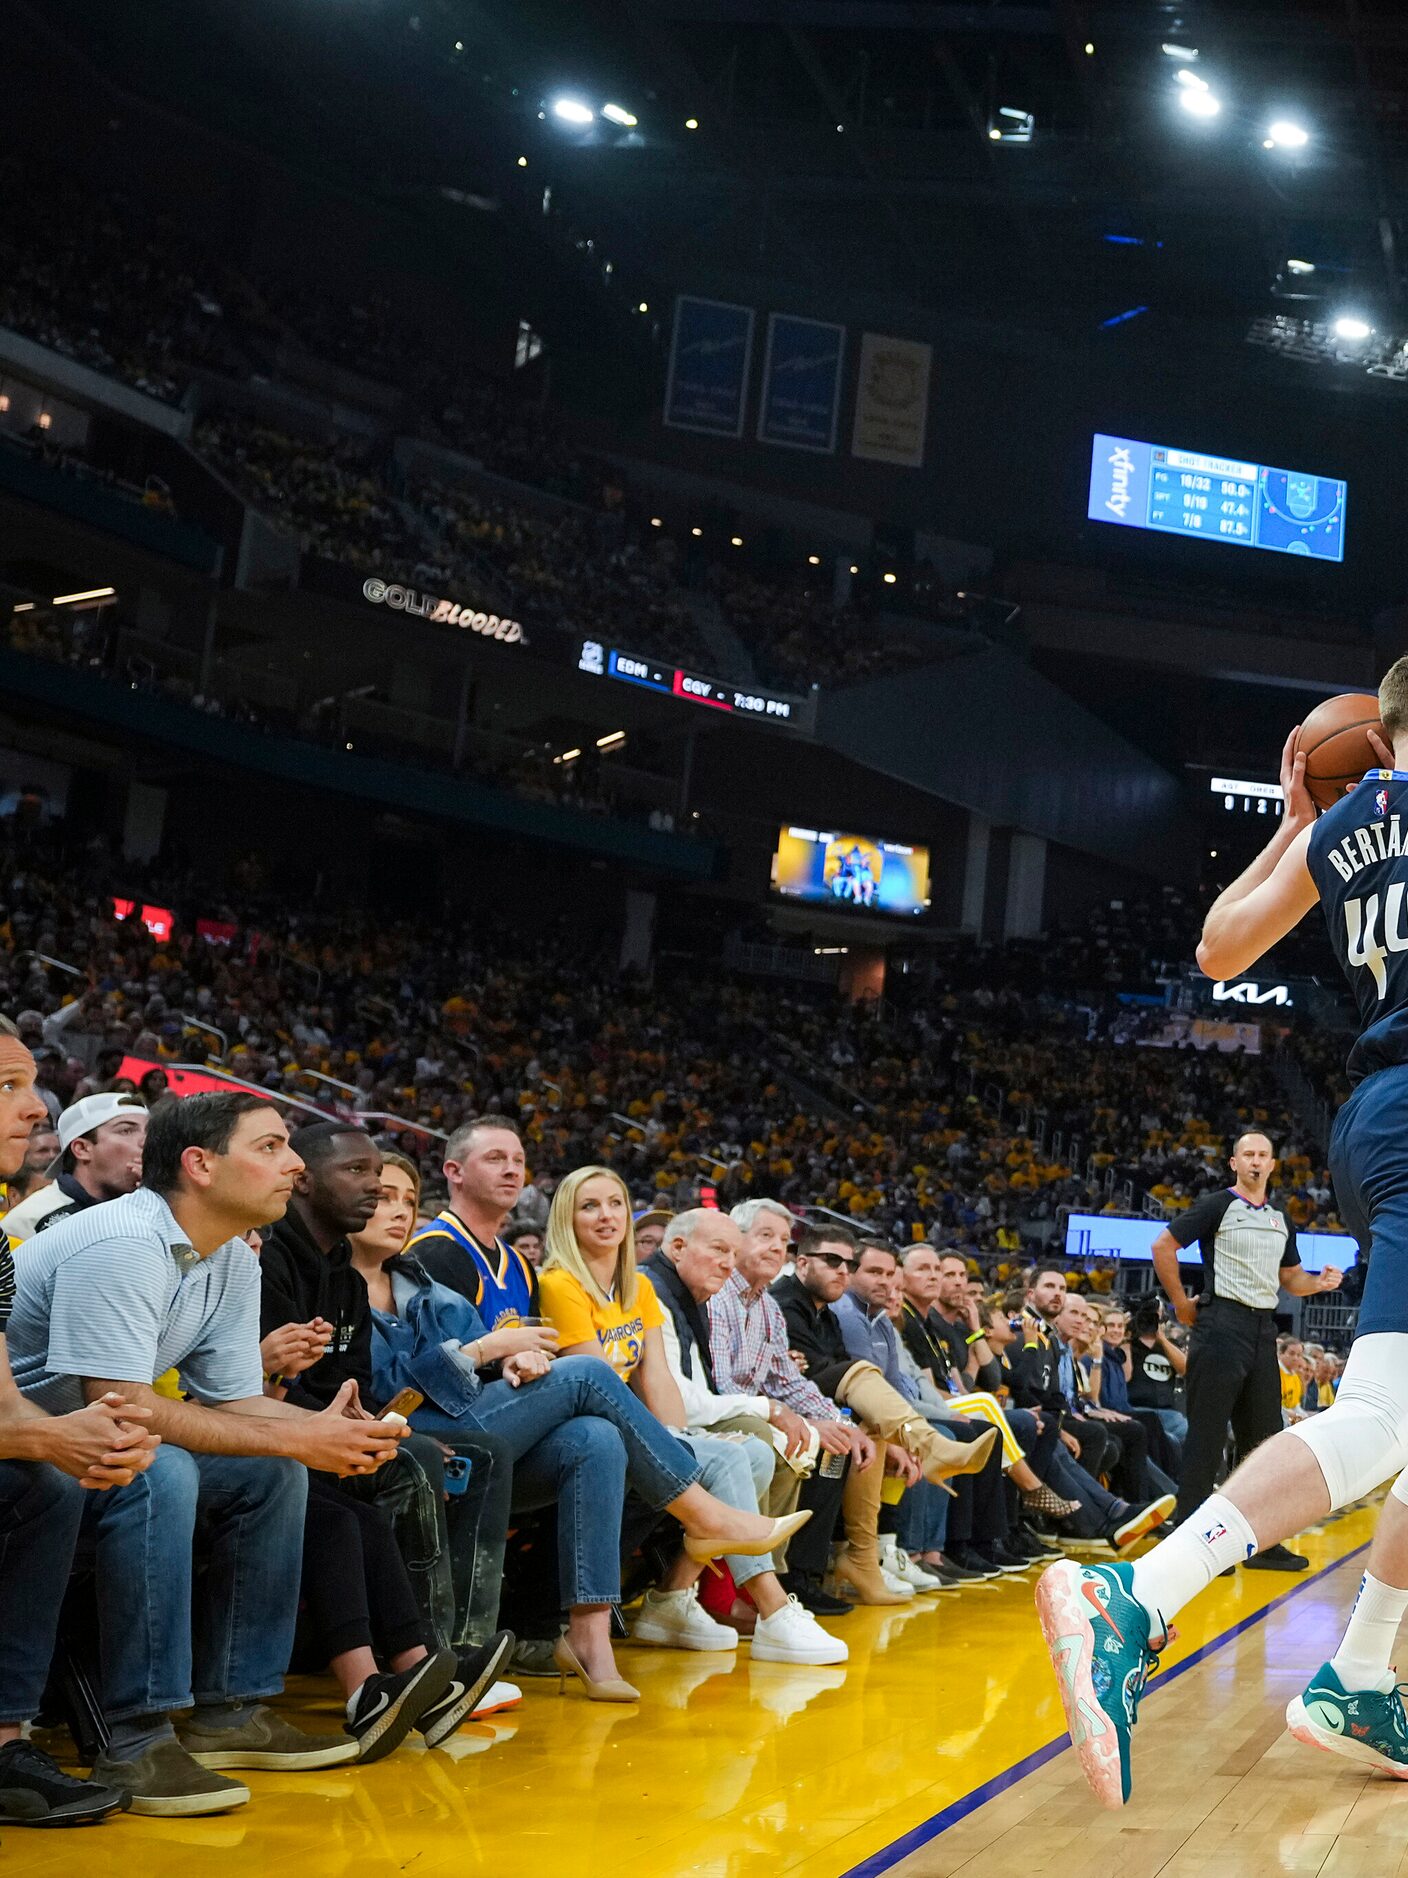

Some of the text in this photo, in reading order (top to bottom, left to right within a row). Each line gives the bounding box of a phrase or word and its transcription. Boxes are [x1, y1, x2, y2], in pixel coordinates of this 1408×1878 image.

[1104, 446, 1135, 518] xfinity
[617, 656, 648, 678] EDM
[682, 677, 712, 697] CGY
[734, 692, 766, 712] 7:30
[766, 700, 791, 717] PM
[1213, 981, 1288, 1006] KIA
[1144, 1362, 1171, 1376] TNT
